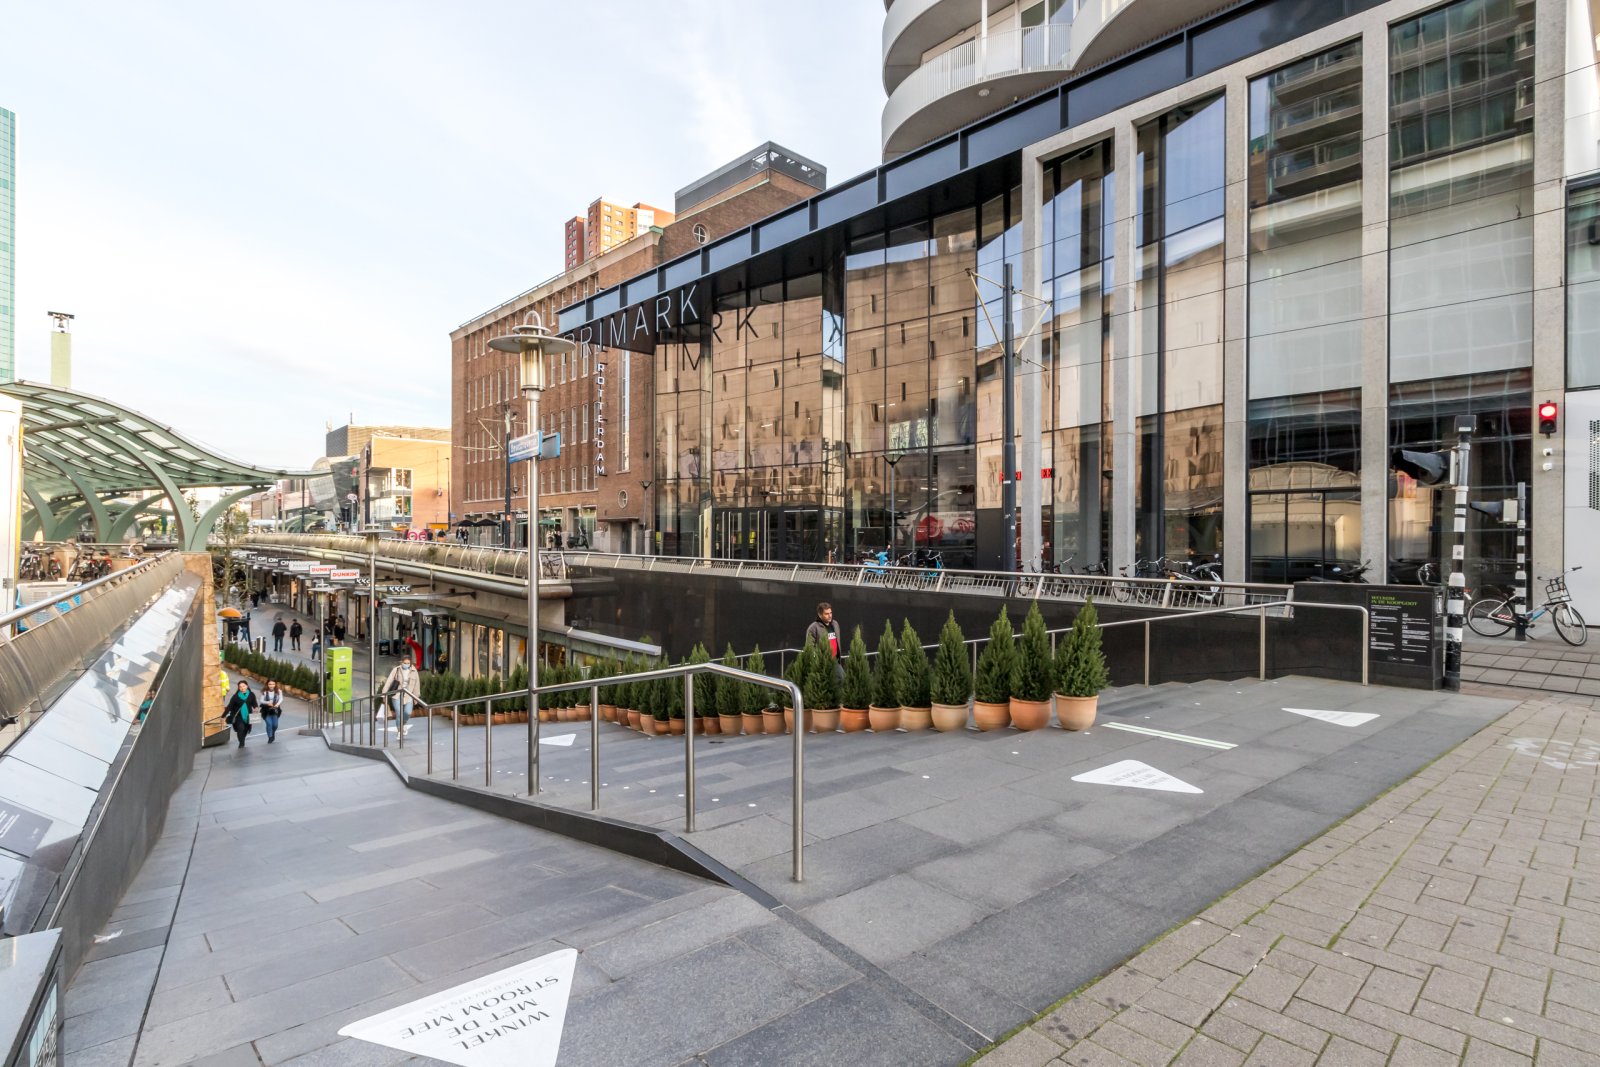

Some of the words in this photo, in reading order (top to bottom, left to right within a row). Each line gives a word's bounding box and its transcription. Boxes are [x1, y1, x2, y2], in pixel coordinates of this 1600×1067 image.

[563, 284, 699, 363] PRIMARK
[597, 363, 605, 474] ROTTERDAM
[462, 975, 560, 1016] STROOM
[488, 997, 540, 1023] MET
[399, 1013, 454, 1040] MEE
[446, 1019, 481, 1040] DE
[451, 1010, 550, 1051] WINKEL
